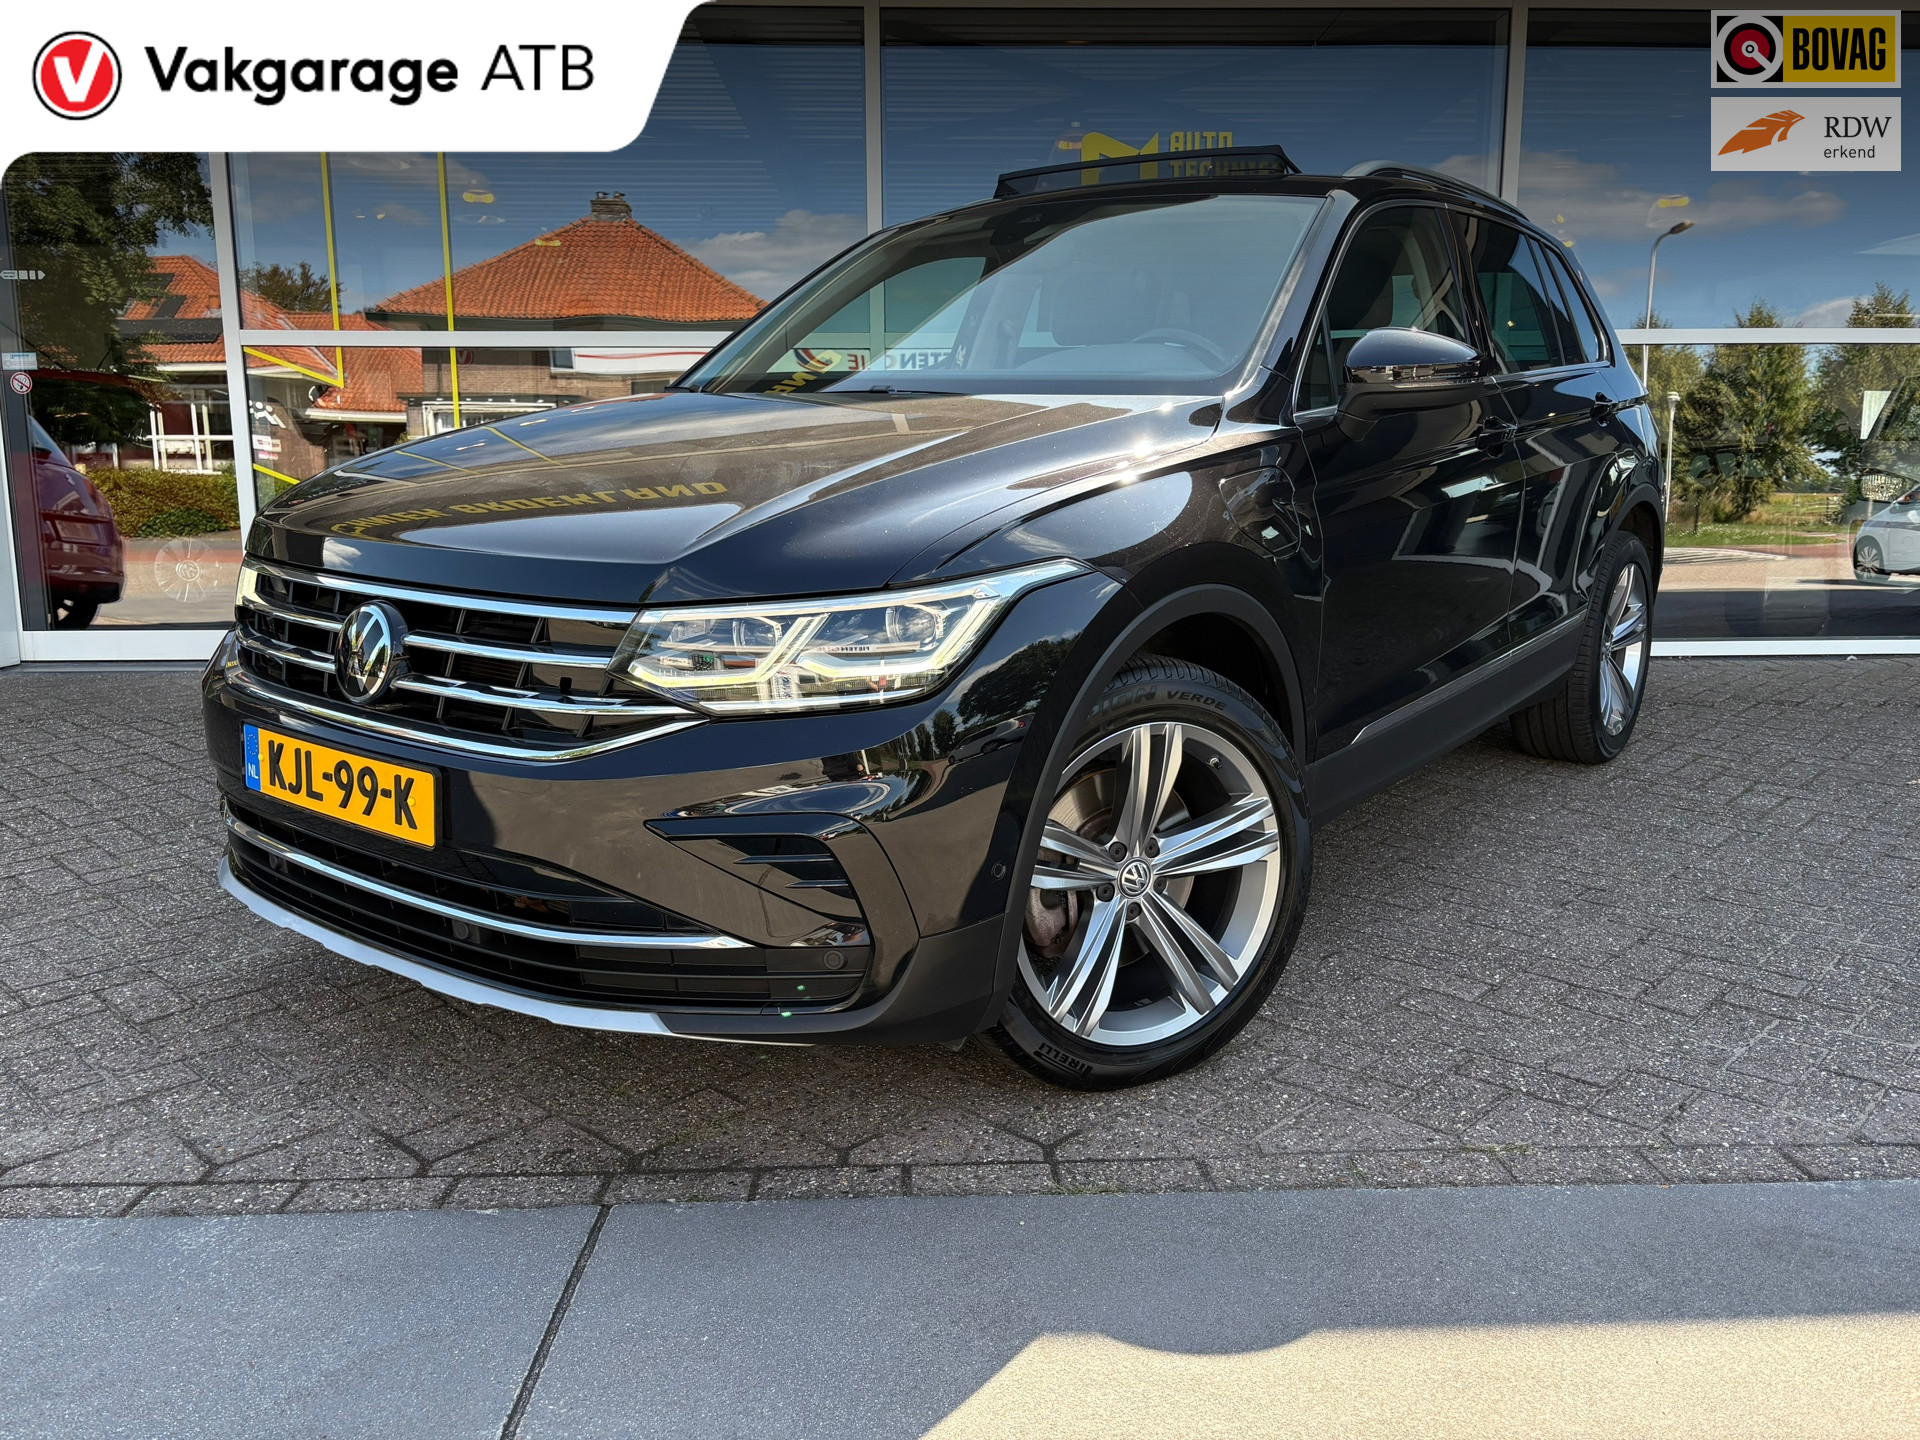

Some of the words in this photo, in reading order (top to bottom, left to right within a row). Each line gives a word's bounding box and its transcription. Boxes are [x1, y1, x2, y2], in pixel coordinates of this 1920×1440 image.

[1166, 690, 1227, 711] VERDE
[247, 763, 259, 779] NL
[268, 740, 418, 830] KJL-99-K
[1033, 1042, 1094, 1080] PIRELLI
